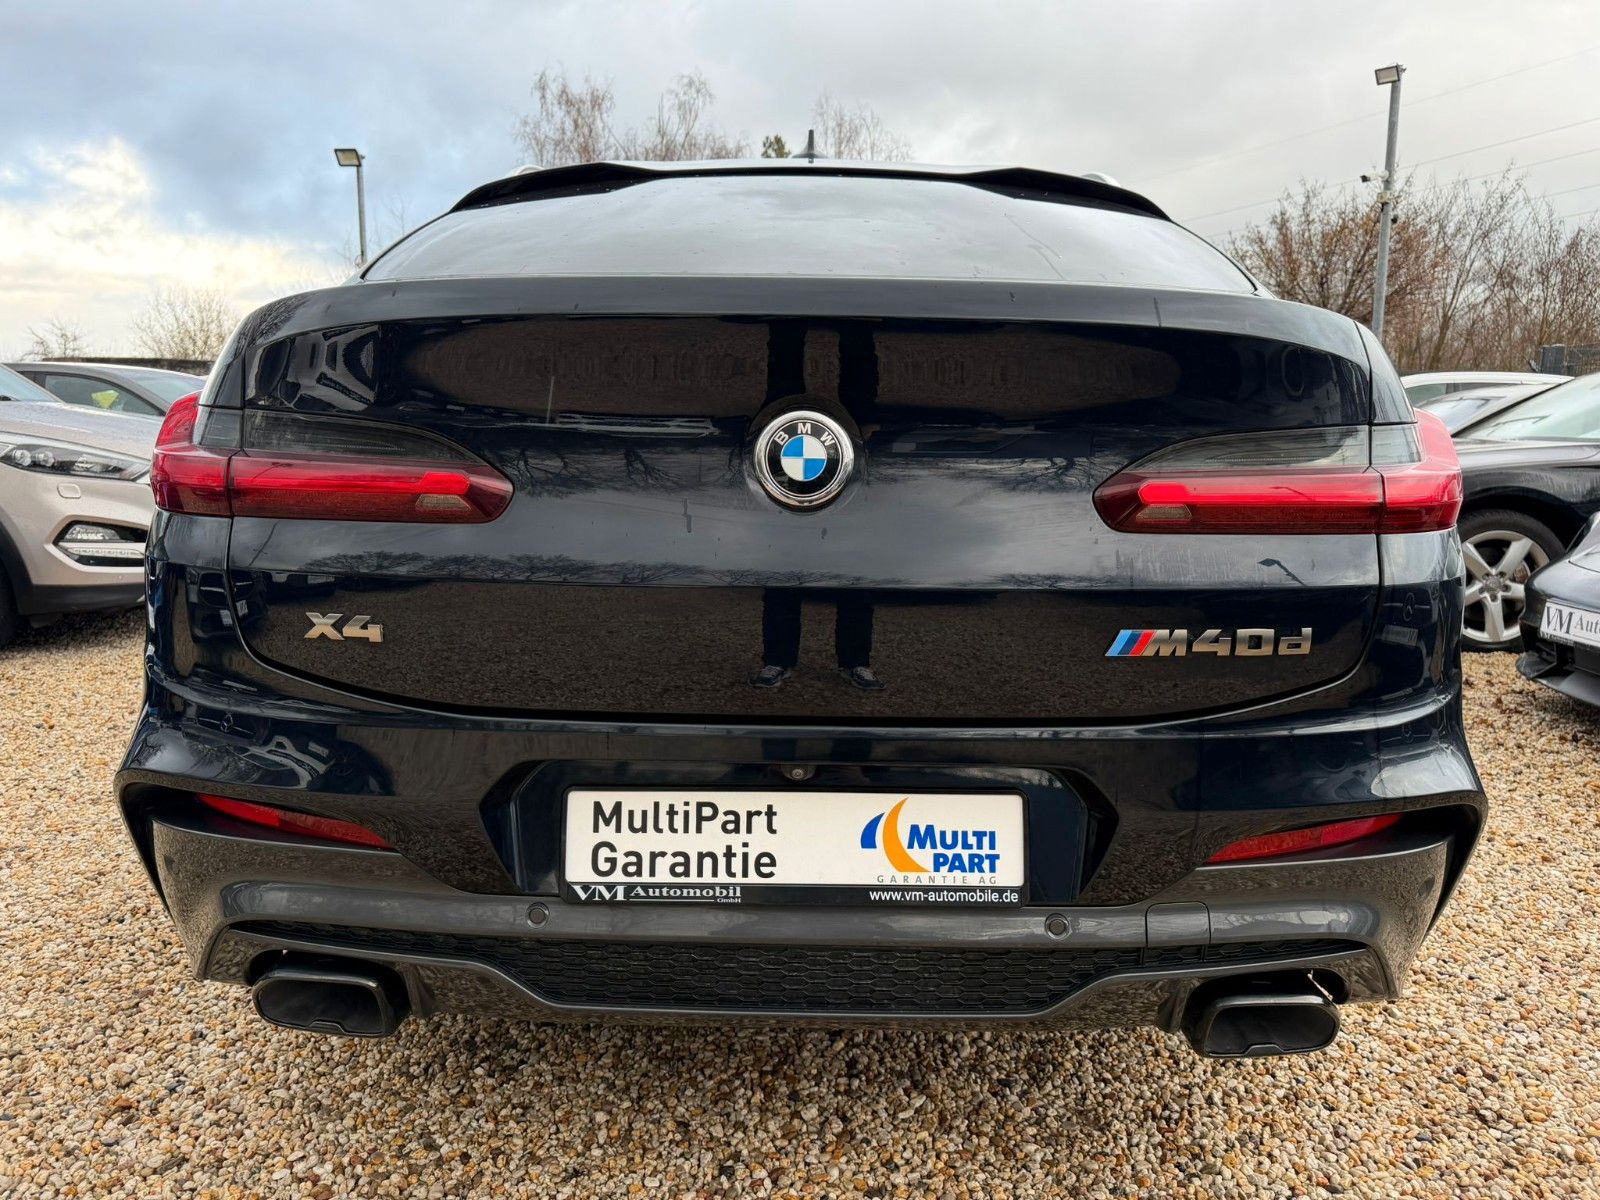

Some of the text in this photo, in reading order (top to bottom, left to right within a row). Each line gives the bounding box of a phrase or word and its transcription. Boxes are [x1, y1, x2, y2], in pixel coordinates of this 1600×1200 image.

[774, 422, 835, 446] BMW
[304, 612, 384, 643] X4
[1545, 606, 1600, 636] VM Aut
[1139, 627, 1313, 656] M40d
[592, 800, 778, 834] MultiPart
[906, 824, 996, 850] MULTI
[591, 841, 777, 878] Garantie
[932, 852, 1000, 873] PART
[572, 885, 742, 901] VM Automobil
[876, 875, 997, 885] GARANTIE AG
[868, 888, 1019, 903] www.vm-automobile.de
